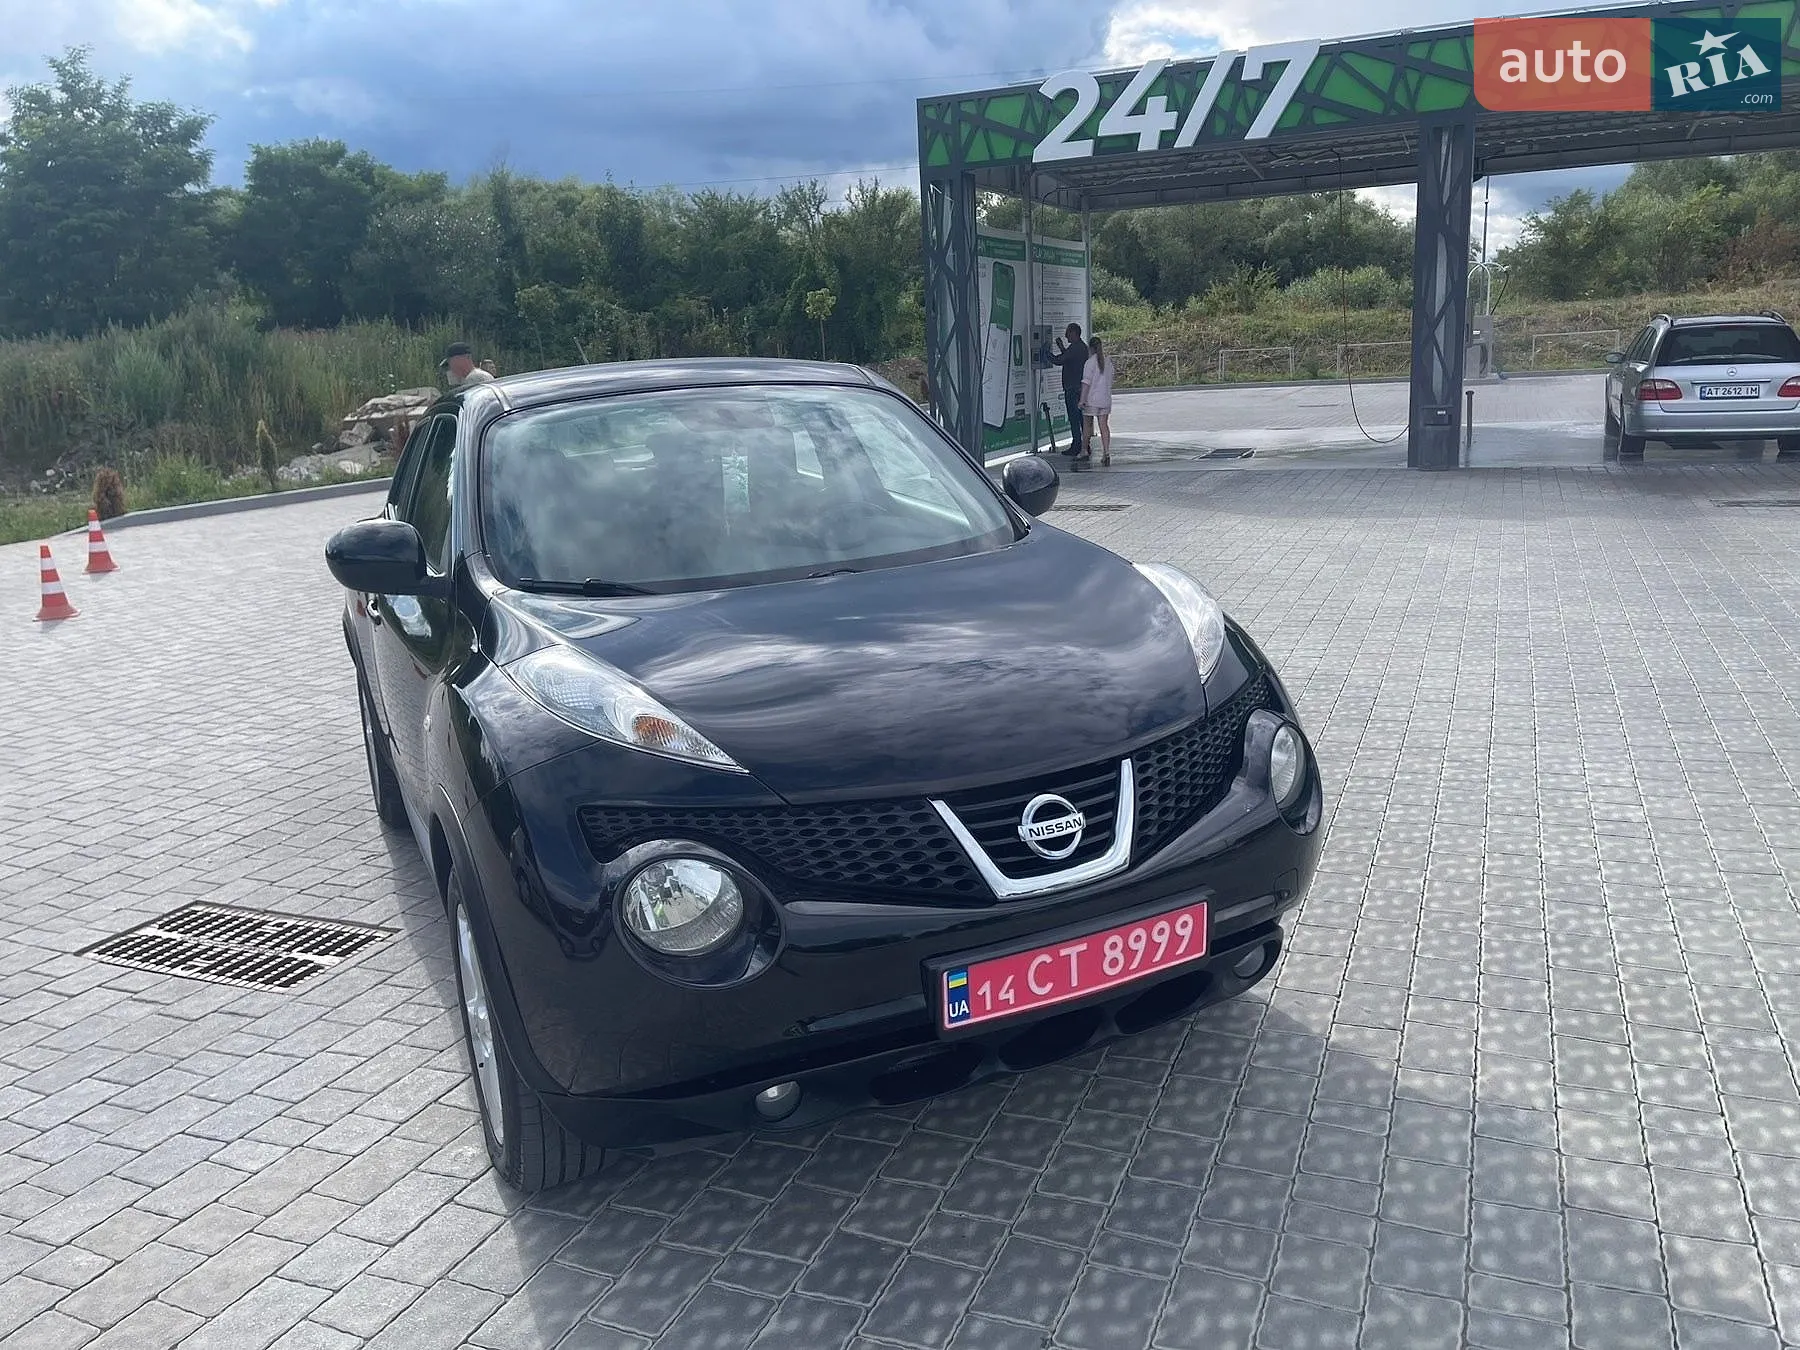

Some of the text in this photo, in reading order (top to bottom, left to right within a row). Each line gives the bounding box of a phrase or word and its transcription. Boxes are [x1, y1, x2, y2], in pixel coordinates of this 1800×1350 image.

[1032, 38, 1321, 163] 24/7
[1706, 386, 1758, 396] AT 2612 IM
[1028, 817, 1082, 837] NISSAN
[977, 913, 1194, 1011] 14 CT 8999
[949, 999, 969, 1018] UA
